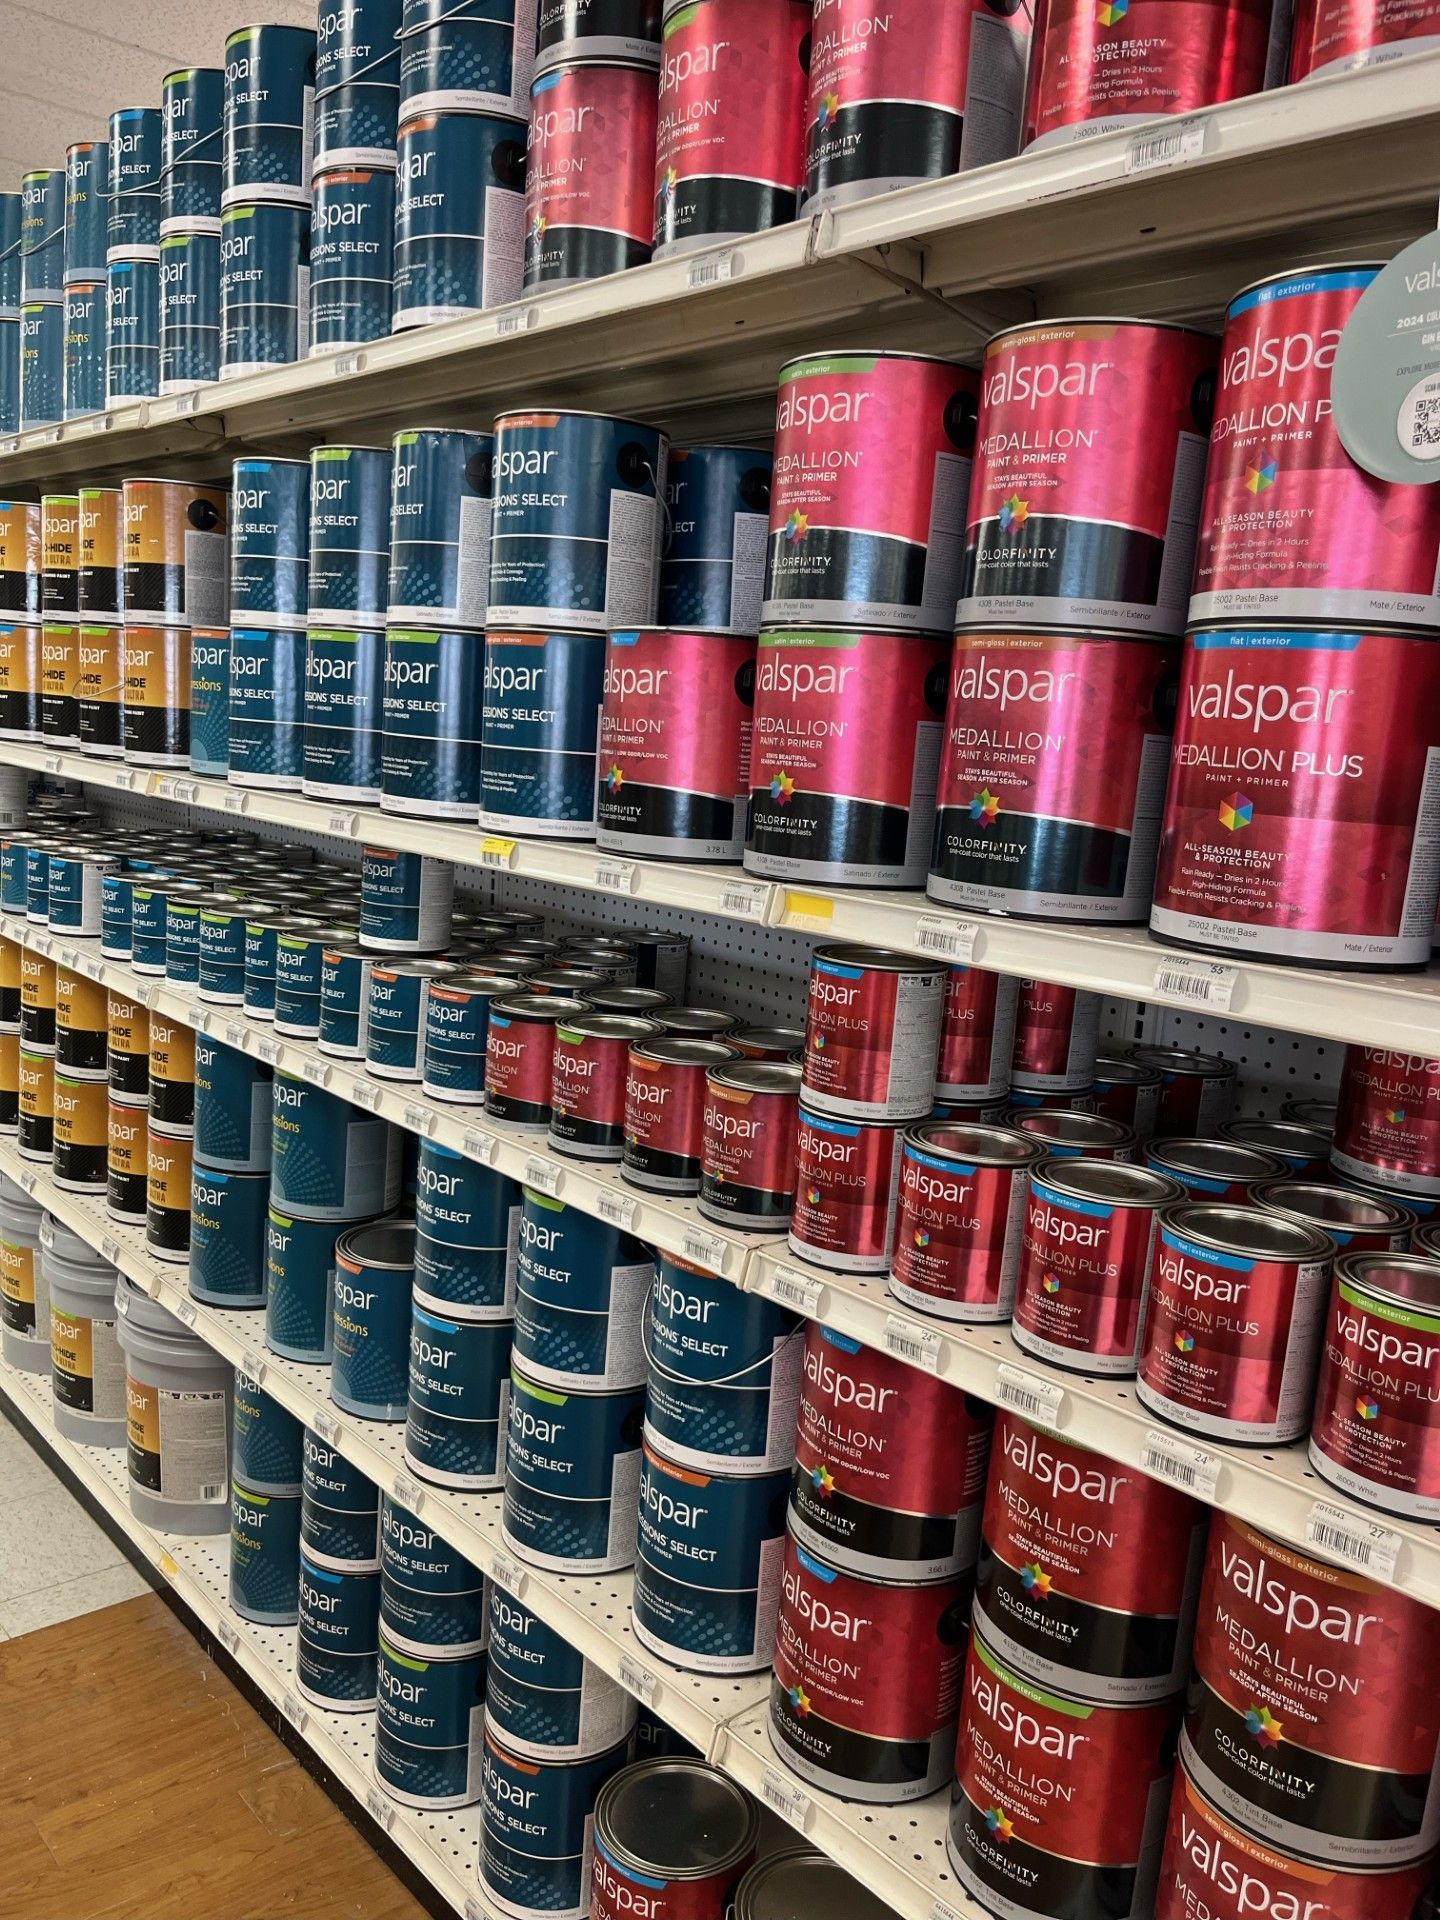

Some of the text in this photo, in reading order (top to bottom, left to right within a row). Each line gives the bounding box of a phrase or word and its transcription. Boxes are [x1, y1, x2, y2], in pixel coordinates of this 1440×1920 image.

[334, 46, 371, 59] SELECT
[833, 41, 867, 62] PRIMER
[1122, 38, 1166, 49] BEAUTY
[658, 42, 726, 99] alspar
[1102, 65, 1162, 78] Dries Hours
[1111, 77, 1143, 87] Formula
[1109, 88, 1141, 98] Cracking
[527, 106, 591, 151] alspar
[672, 122, 699, 138] PRIMER
[408, 193, 444, 207] SELECT
[339, 241, 379, 253] SELECT
[1277, 281, 1316, 297] exterior
[1396, 314, 1424, 329] 2024
[1041, 331, 1075, 341] exterior
[1222, 327, 1342, 390] valspa
[806, 366, 831, 375] exterior
[984, 356, 1109, 410] valspar
[978, 429, 1094, 458] MEDALLION
[1233, 431, 1312, 449] PAINT PRIMER
[987, 452, 1067, 469] PAINT PRIMER
[802, 472, 838, 483] PRIMER
[522, 494, 568, 507] SELECT
[1268, 509, 1314, 519] BEAUTY
[1229, 520, 1293, 532] PROTECTION
[50, 555, 71, 565] ULTRA
[1017, 560, 1031, 568] that
[893, 610, 917, 619] Exterior
[1370, 600, 1426, 612] Mate Exterior
[1127, 612, 1152, 620] Exterior
[790, 638, 815, 646] exterior
[972, 639, 1043, 648] semi-gloss exterior
[1230, 636, 1291, 646] flat exterior
[384, 653, 436, 689] alspar
[484, 657, 542, 697] alspar
[604, 659, 669, 703] alspar
[954, 656, 1075, 711] valspar
[407, 699, 448, 713] SELECT
[1189, 669, 1348, 734] valspar
[512, 709, 556, 722] SELECT
[617, 735, 644, 744] PRIMER
[787, 739, 822, 749] PRIMER
[950, 728, 1061, 752] MEDALLION
[957, 750, 1036, 764] PAINT PRIMER
[1292, 751, 1364, 778] PLUS
[978, 775, 1028, 786] AFTER SEASON
[982, 769, 1016, 779] BEAUTIFUL
[1205, 774, 1289, 787] PAINT PRIMER
[754, 812, 817, 829] COLORFINITY
[947, 836, 1027, 854] COLORFINITY
[1184, 842, 1291, 861] ALL-SEASON BEAUTY
[1003, 854, 1019, 863] lasts
[1202, 853, 1271, 869] PROTECTION
[1195, 868, 1288, 888] Ready Dries Hours
[1192, 880, 1267, 897] High-Hiding Formula
[1040, 899, 1118, 912] Semibrillante Exterior
[1186, 889, 1265, 909] Finish Resists Cracking
[1188, 920, 1258, 938] 25002 Pastel Base
[1344, 943, 1393, 953] Mate Exterior
[811, 975, 857, 1006] alspar
[1024, 1000, 1053, 1012] PLUS
[837, 1017, 869, 1031] PLUS
[553, 1048, 597, 1077] alspar
[834, 1173, 866, 1187] PLUS
[903, 1165, 969, 1203] valspar
[434, 1207, 471, 1224] SELECT
[946, 1214, 981, 1230] PLUS
[1029, 1205, 1106, 1247] valspar
[1192, 1249, 1220, 1261] exterior
[534, 1265, 571, 1284] SELECT
[1079, 1259, 1118, 1277] PLUS
[1159, 1254, 1247, 1304] valspar
[652, 1270, 715, 1323] alspar
[1056, 1303, 1081, 1314] BEAUTY
[1357, 1297, 1411, 1322] satin exterior
[1216, 1316, 1259, 1336] PLUS
[681, 1335, 728, 1357] SELECT
[1336, 1310, 1440, 1369] valspar
[1190, 1362, 1219, 1376] BEAUTY
[1344, 1427, 1392, 1450] PROTECTION
[1373, 1431, 1407, 1448] BEAUTY
[829, 1438, 863, 1460] PRIMER
[532, 1454, 574, 1473] SELECT
[1003, 1424, 1127, 1504] valspar
[640, 1474, 704, 1529] alspar
[998, 1480, 1114, 1549] MEDALLION
[1007, 1509, 1089, 1556] PAINT PRIMER
[670, 1540, 717, 1562] SELECT
[1247, 1533, 1339, 1582] semi-gloss exterior
[411, 1556, 449, 1574] SELECT
[1221, 1541, 1377, 1646] valspar
[997, 1586, 1079, 1637] COLORFINITY
[506, 1647, 545, 1665] SELECT
[1216, 1605, 1359, 1696] MEDALLION
[1228, 1642, 1329, 1703] PAINT PRIMER
[1012, 1679, 1042, 1701] exterior
[1238, 1669, 1305, 1711] STAYS BEAUTIFUL
[971, 1664, 1085, 1760] valspar
[1256, 1688, 1318, 1723] AFTER SEASON
[967, 1719, 1072, 1802] MEDALLION
[1214, 1728, 1316, 1792] COLORFINITY
[1247, 1766, 1305, 1799] color that lasts
[1007, 1780, 1048, 1807] PRIMER
[507, 1819, 547, 1836] SELECT
[1263, 1811, 1283, 1829] Base
[1204, 1812, 1288, 1870] semi-gloss exterior
[964, 1823, 1039, 1882] COLORFINITY
[1181, 1813, 1324, 1920] valspar
